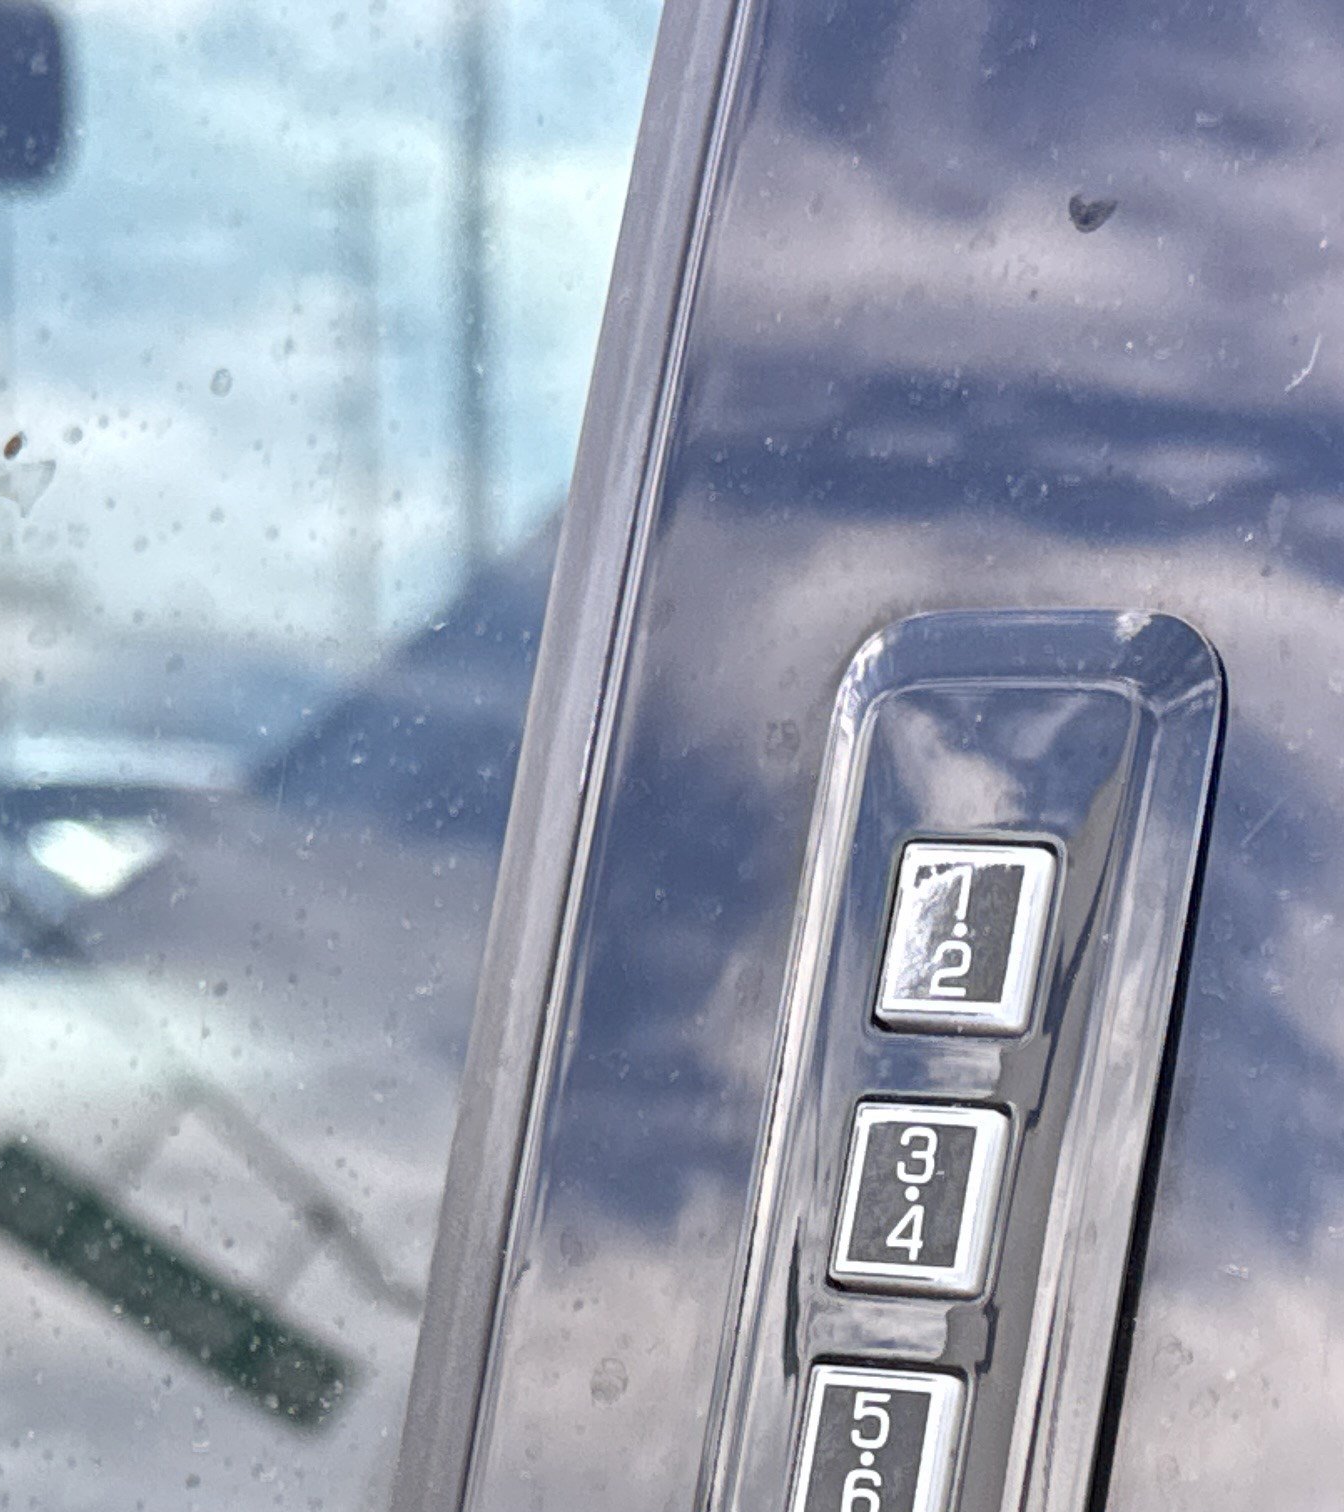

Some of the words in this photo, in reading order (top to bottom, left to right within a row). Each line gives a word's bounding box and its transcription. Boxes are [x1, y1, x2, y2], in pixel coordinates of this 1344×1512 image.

[949, 864, 973, 921] 1
[929, 940, 973, 997] 2
[896, 1127, 938, 1185] 3
[885, 1205, 925, 1261] 4
[851, 1391, 891, 1449] 5
